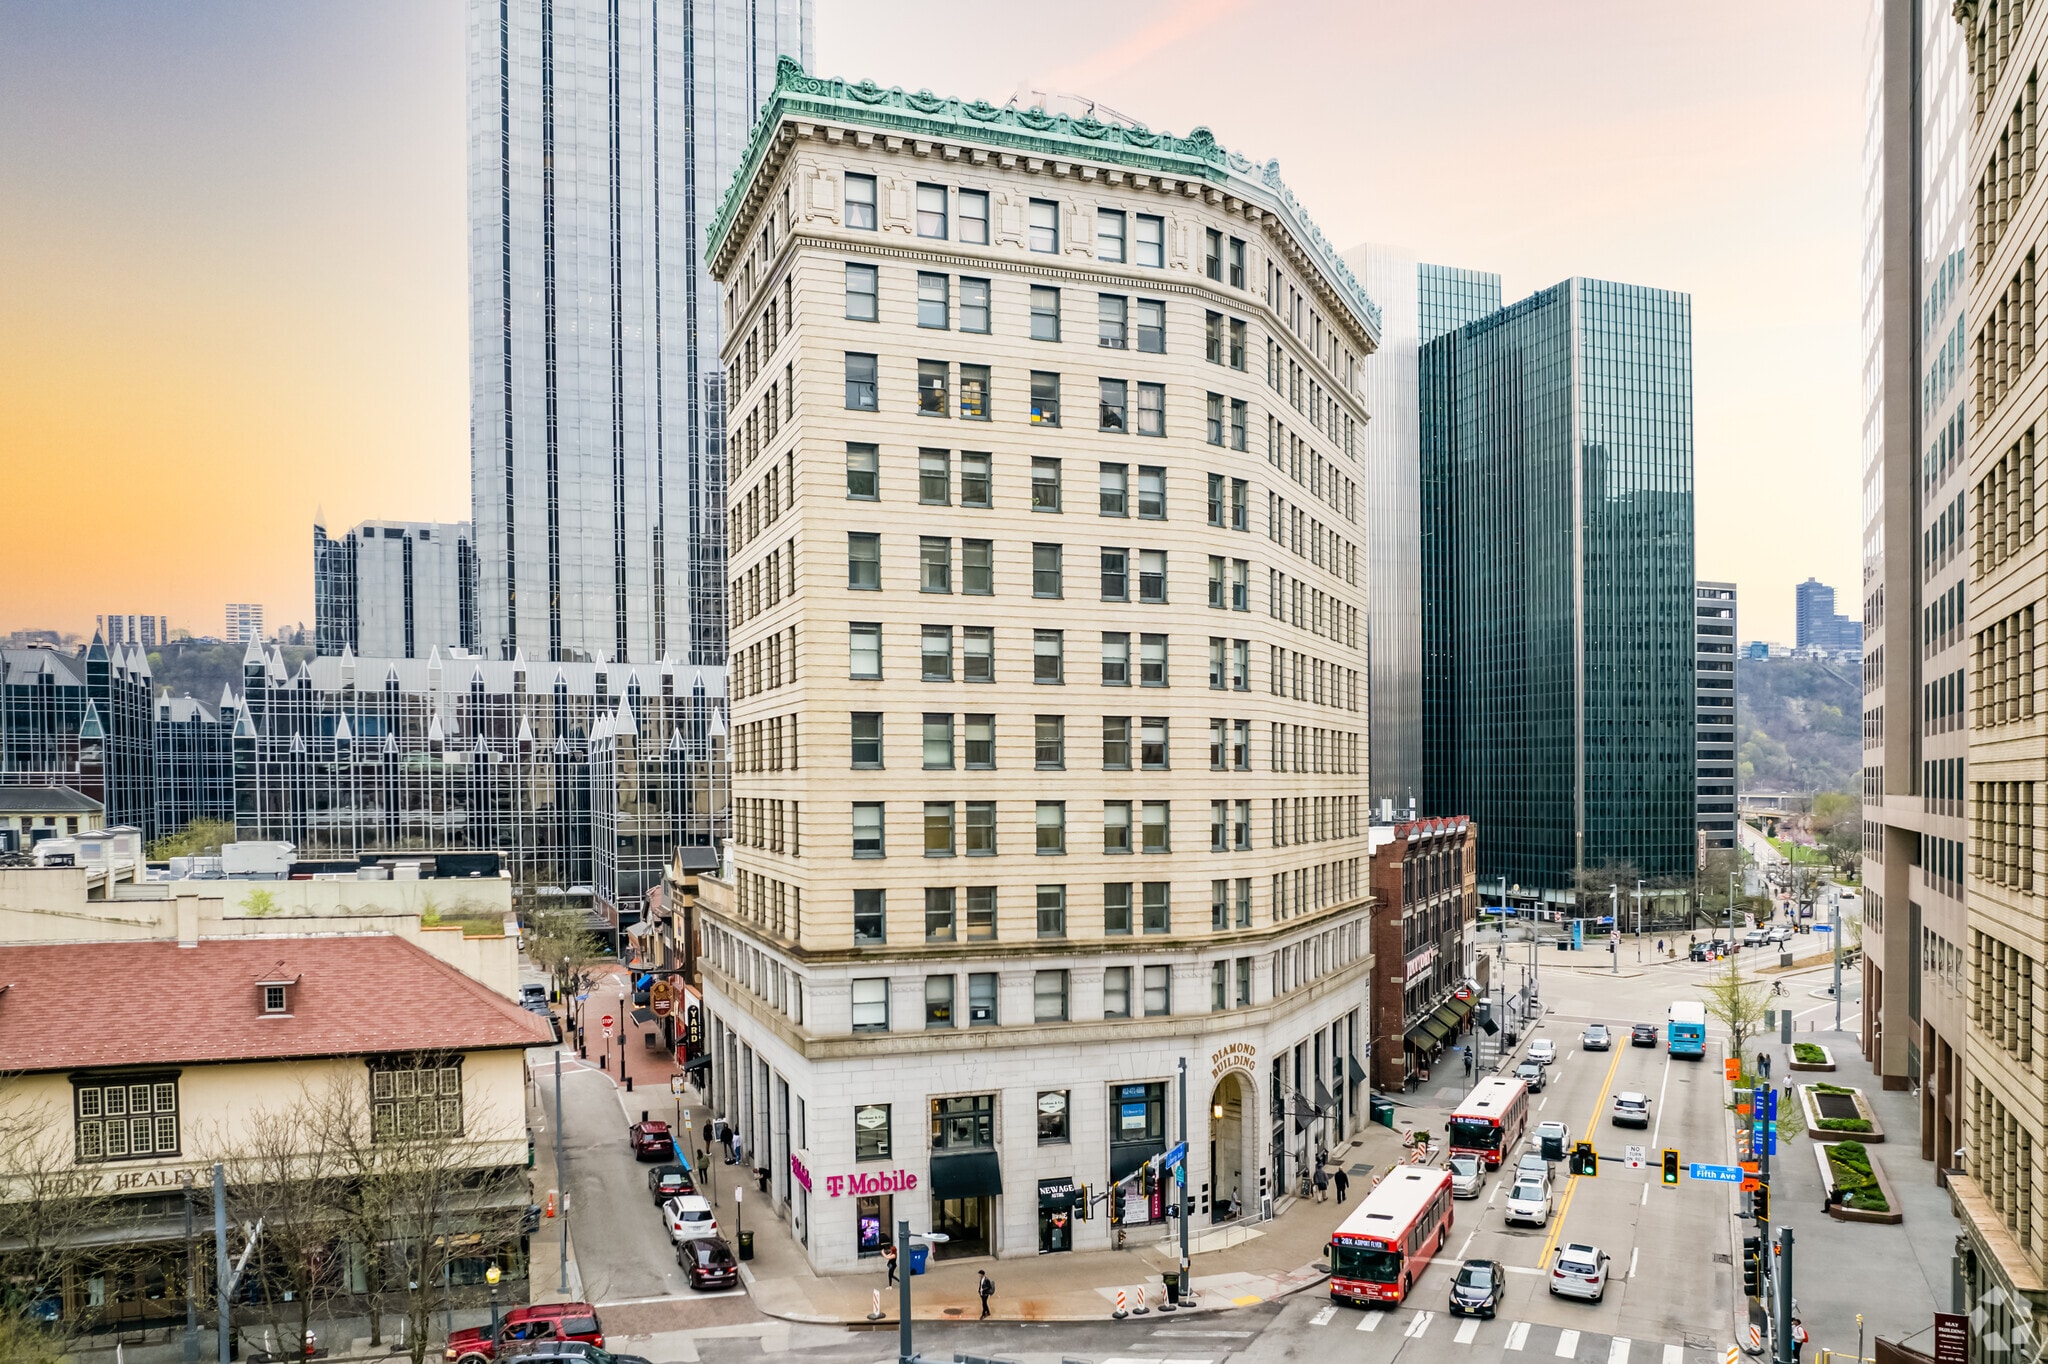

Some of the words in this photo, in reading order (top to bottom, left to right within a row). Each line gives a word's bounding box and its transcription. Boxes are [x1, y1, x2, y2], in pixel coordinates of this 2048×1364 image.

[690, 1010, 698, 1043] YARD
[1212, 1042, 1256, 1065] DIAMOND
[1212, 1055, 1256, 1079] BUILDING
[827, 1175, 844, 1197] T
[847, 1169, 918, 1196] Mobile
[1696, 1170, 1717, 1179] Fifth
[1720, 1172, 1737, 1181] Ave
[1341, 1237, 1353, 1245] 28X
[1354, 1239, 1371, 1247] AIRPORT
